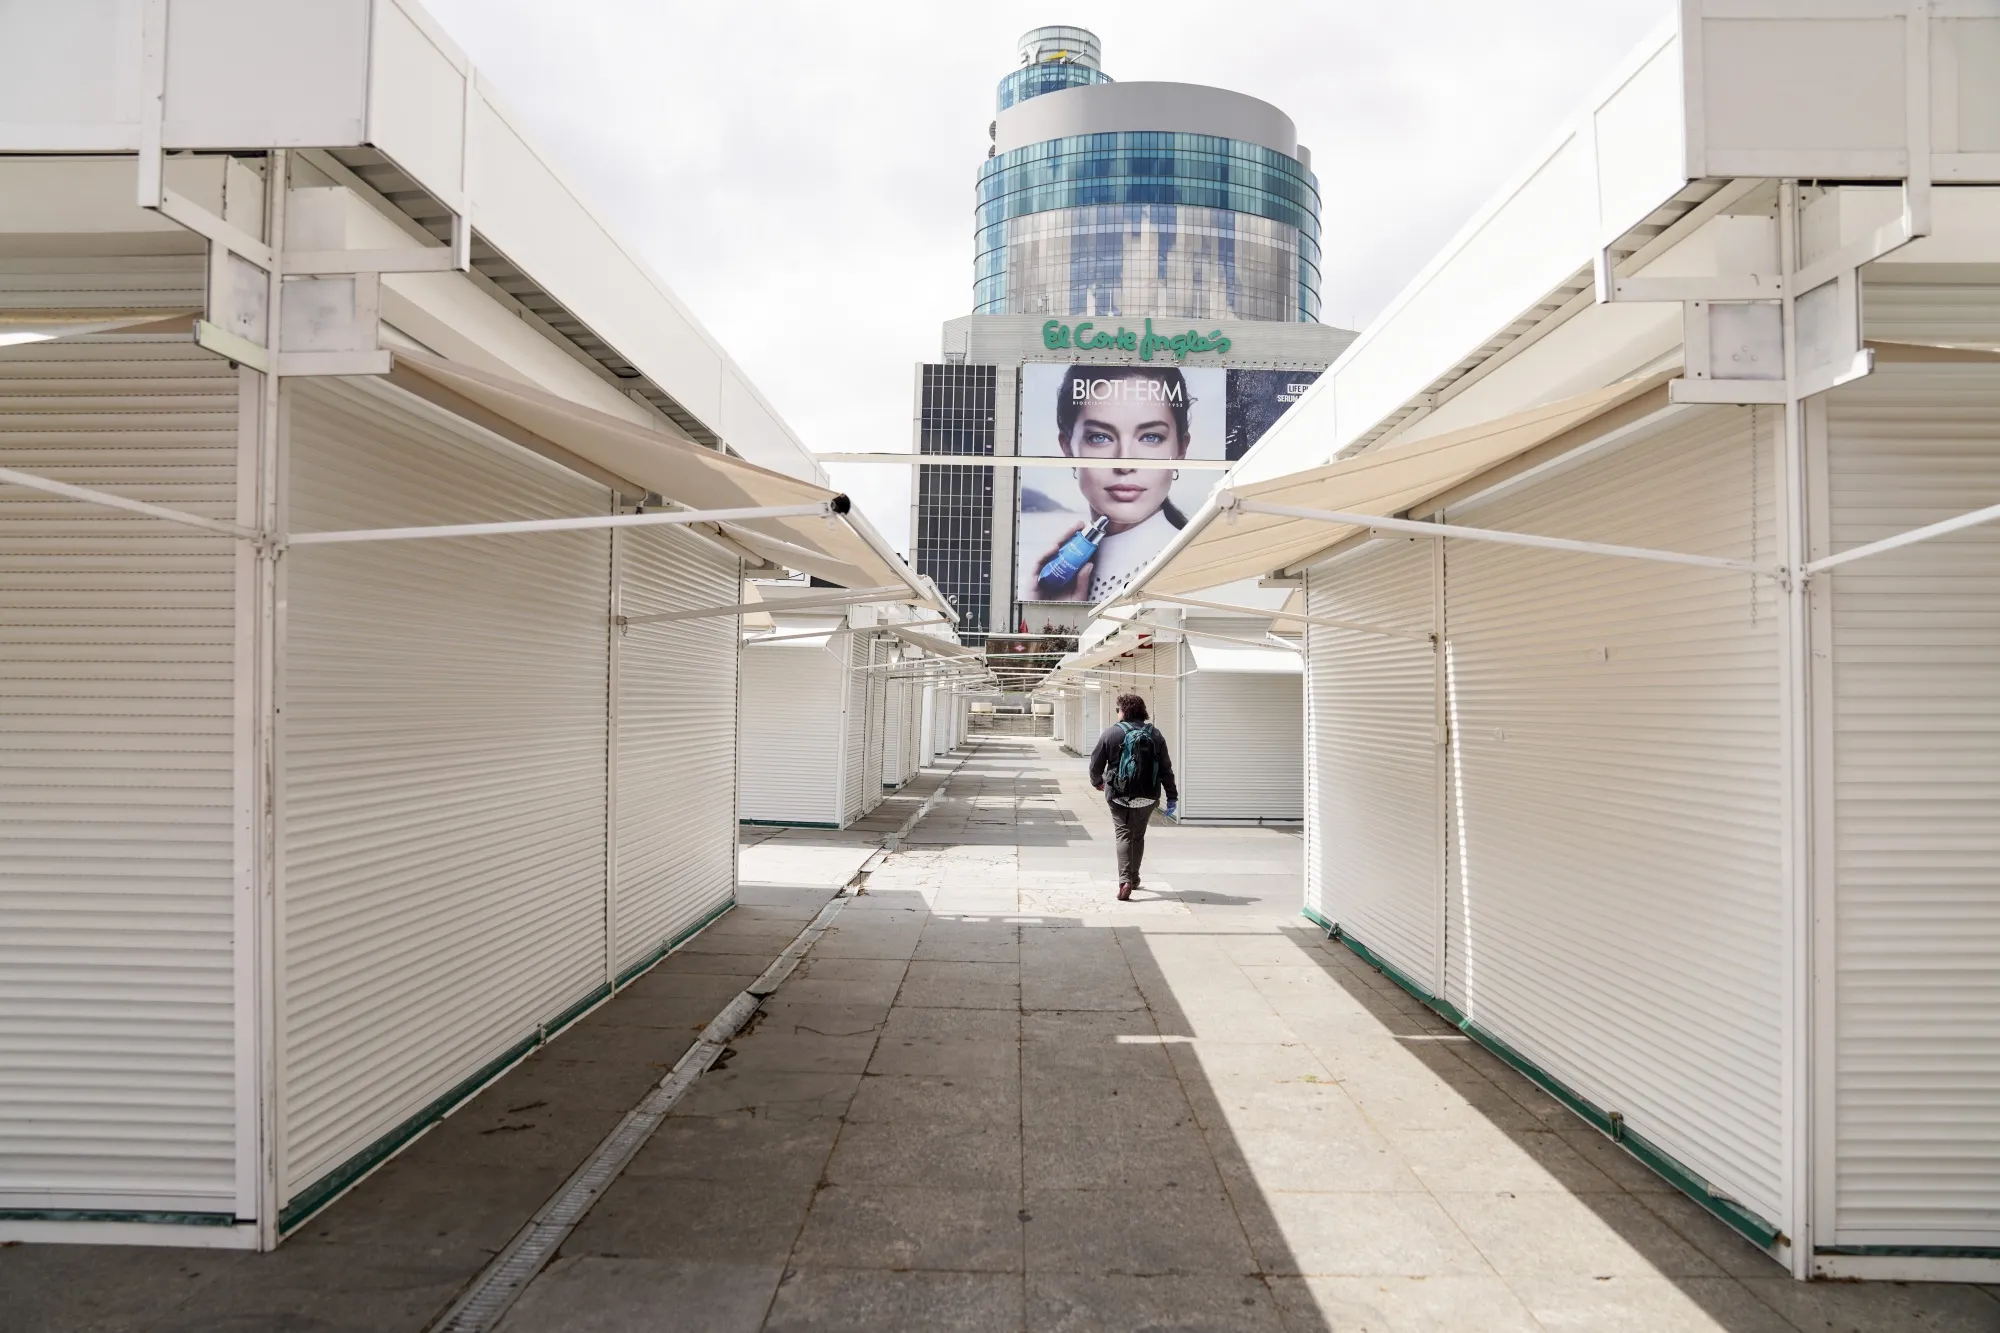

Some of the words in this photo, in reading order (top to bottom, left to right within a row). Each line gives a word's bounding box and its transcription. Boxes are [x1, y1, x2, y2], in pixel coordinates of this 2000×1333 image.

[1043, 319, 1071, 350] El
[1074, 322, 1137, 351] Corte
[1139, 317, 1231, 361] Inglés
[1072, 378, 1183, 402] BIOTHERM
